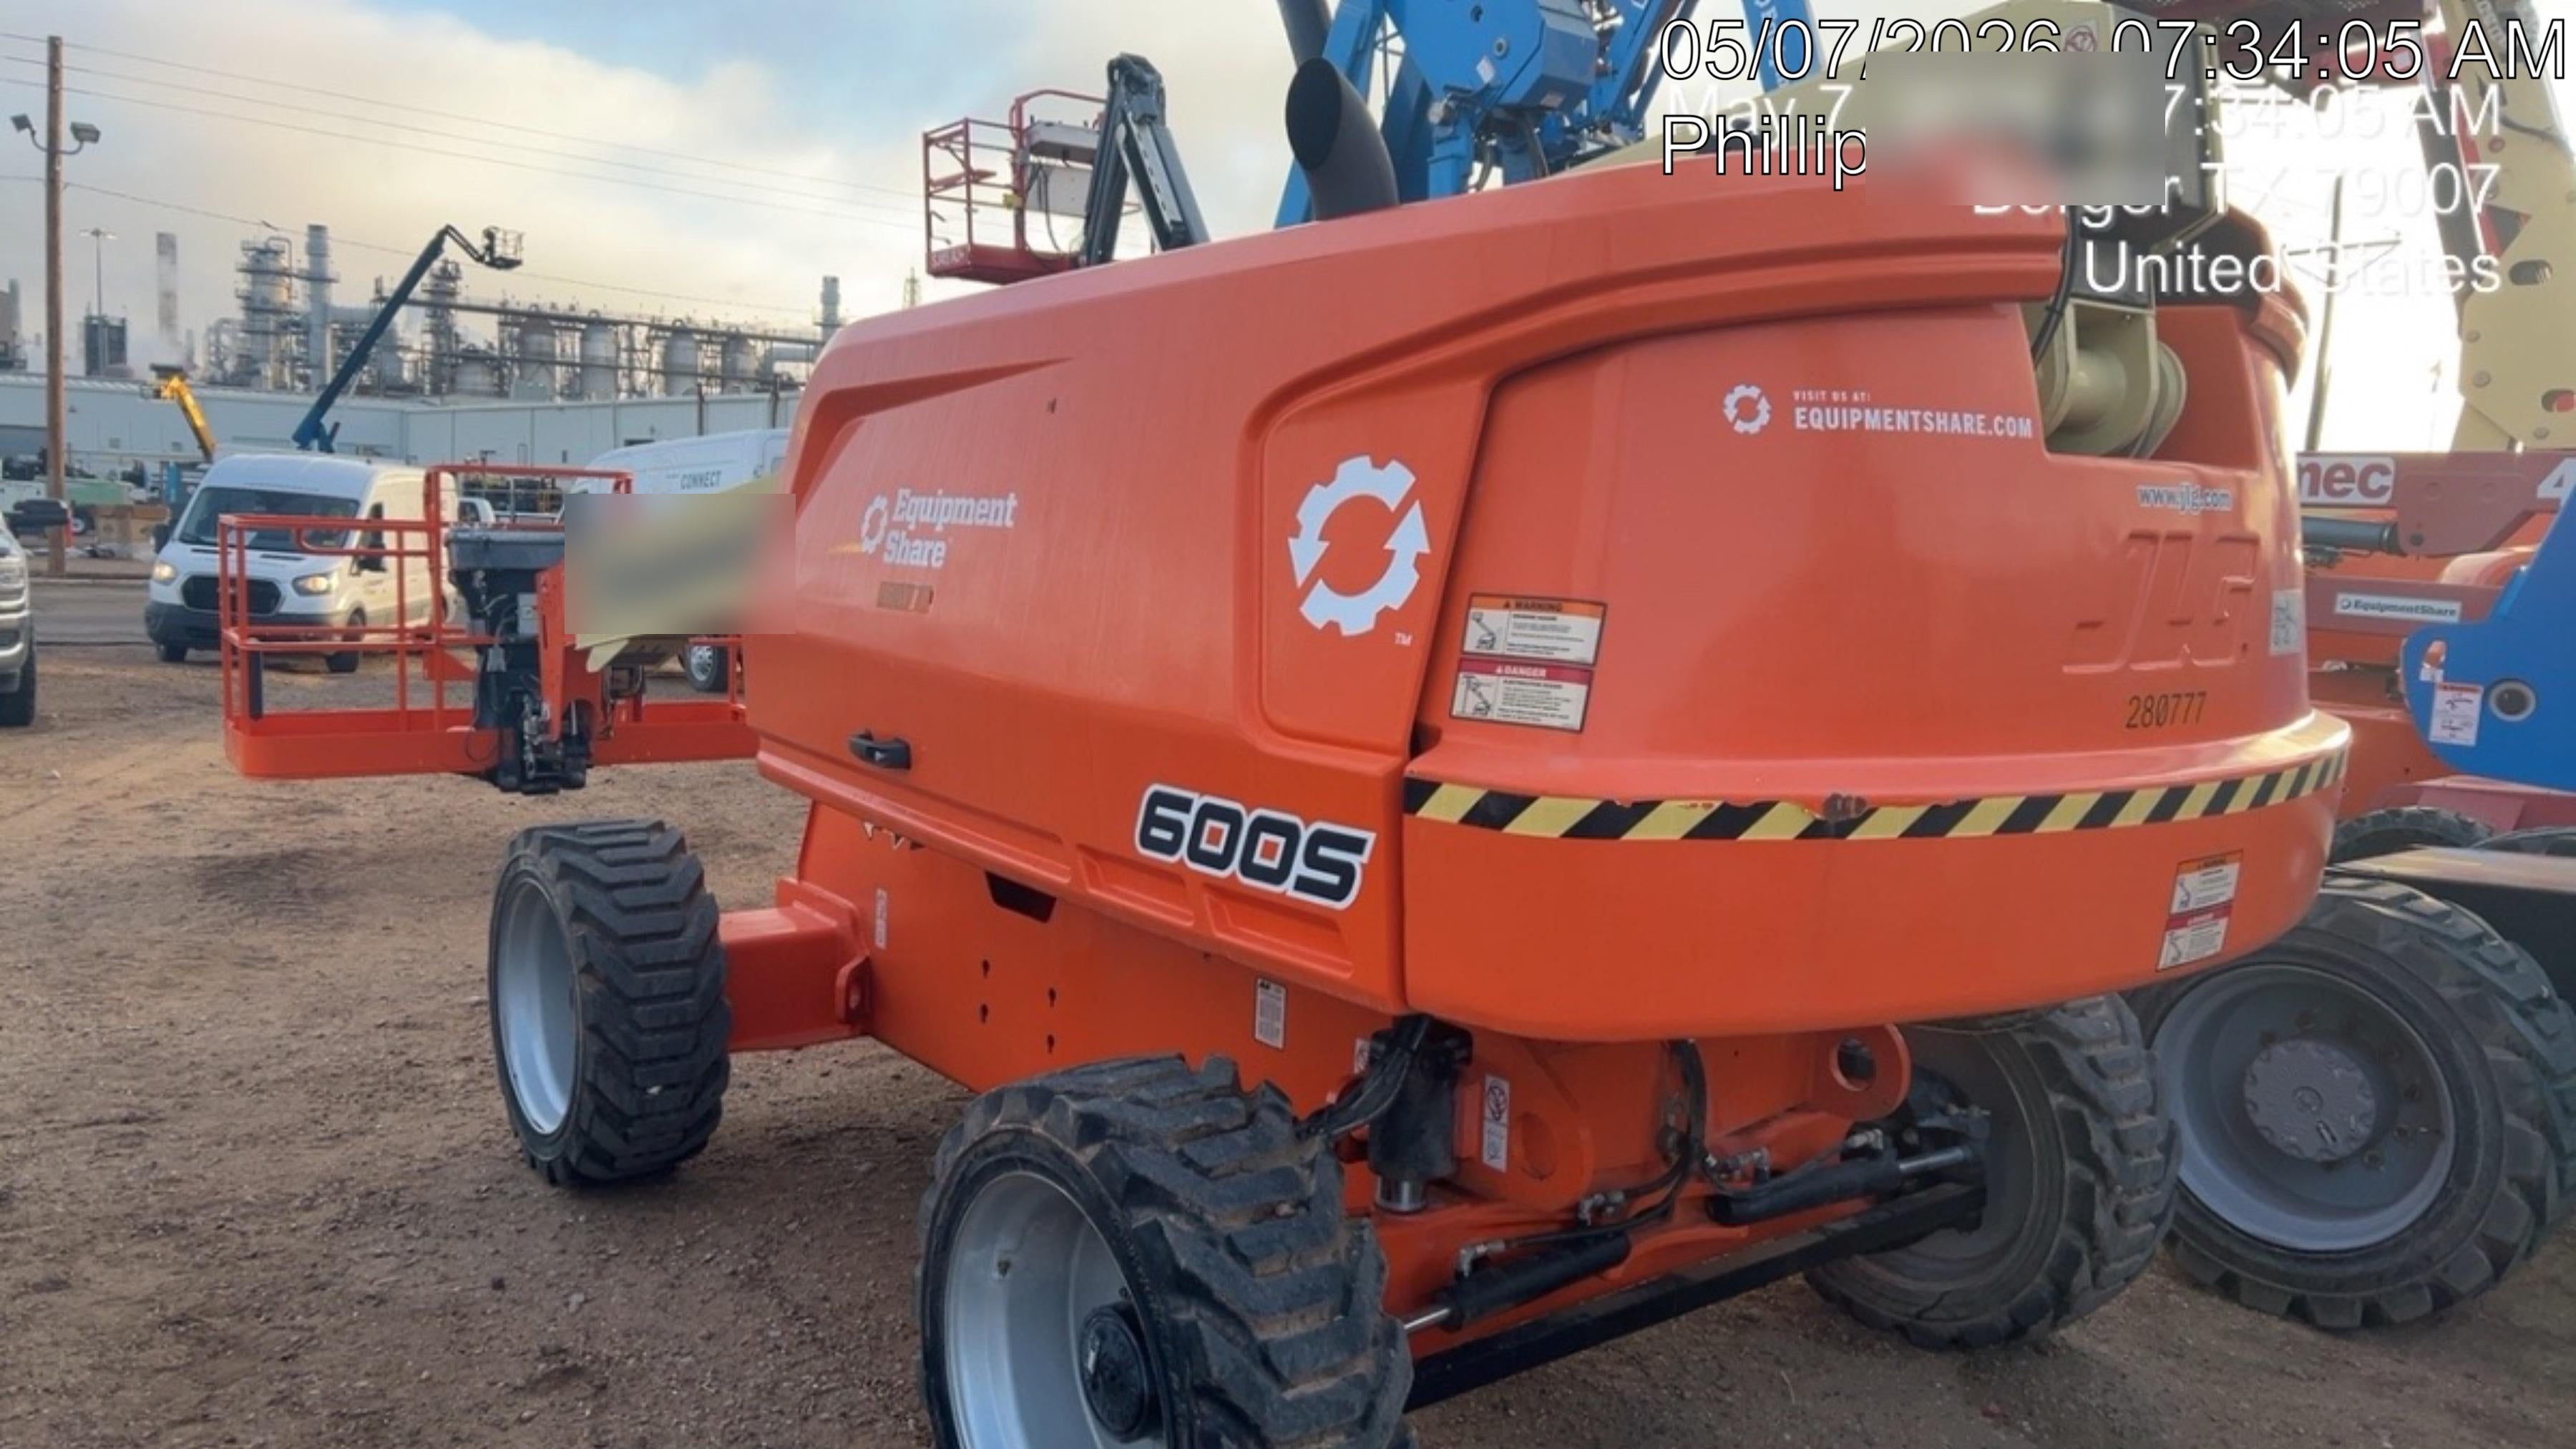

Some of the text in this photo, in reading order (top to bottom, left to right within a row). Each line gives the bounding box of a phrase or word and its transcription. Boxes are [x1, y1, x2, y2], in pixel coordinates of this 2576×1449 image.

[1793, 390, 1827, 401] VISIT
[1832, 391, 1848, 401] US
[1795, 406, 2033, 439] EQUIPMENTSHARE.COM
[893, 488, 1017, 531] Equipment
[2137, 482, 2232, 514] www.jlg.com
[883, 529, 946, 568] Share
[2354, 598, 2457, 617] EquipmentShare
[2125, 691, 2207, 729] 280777
[1135, 783, 1377, 911] 600S
